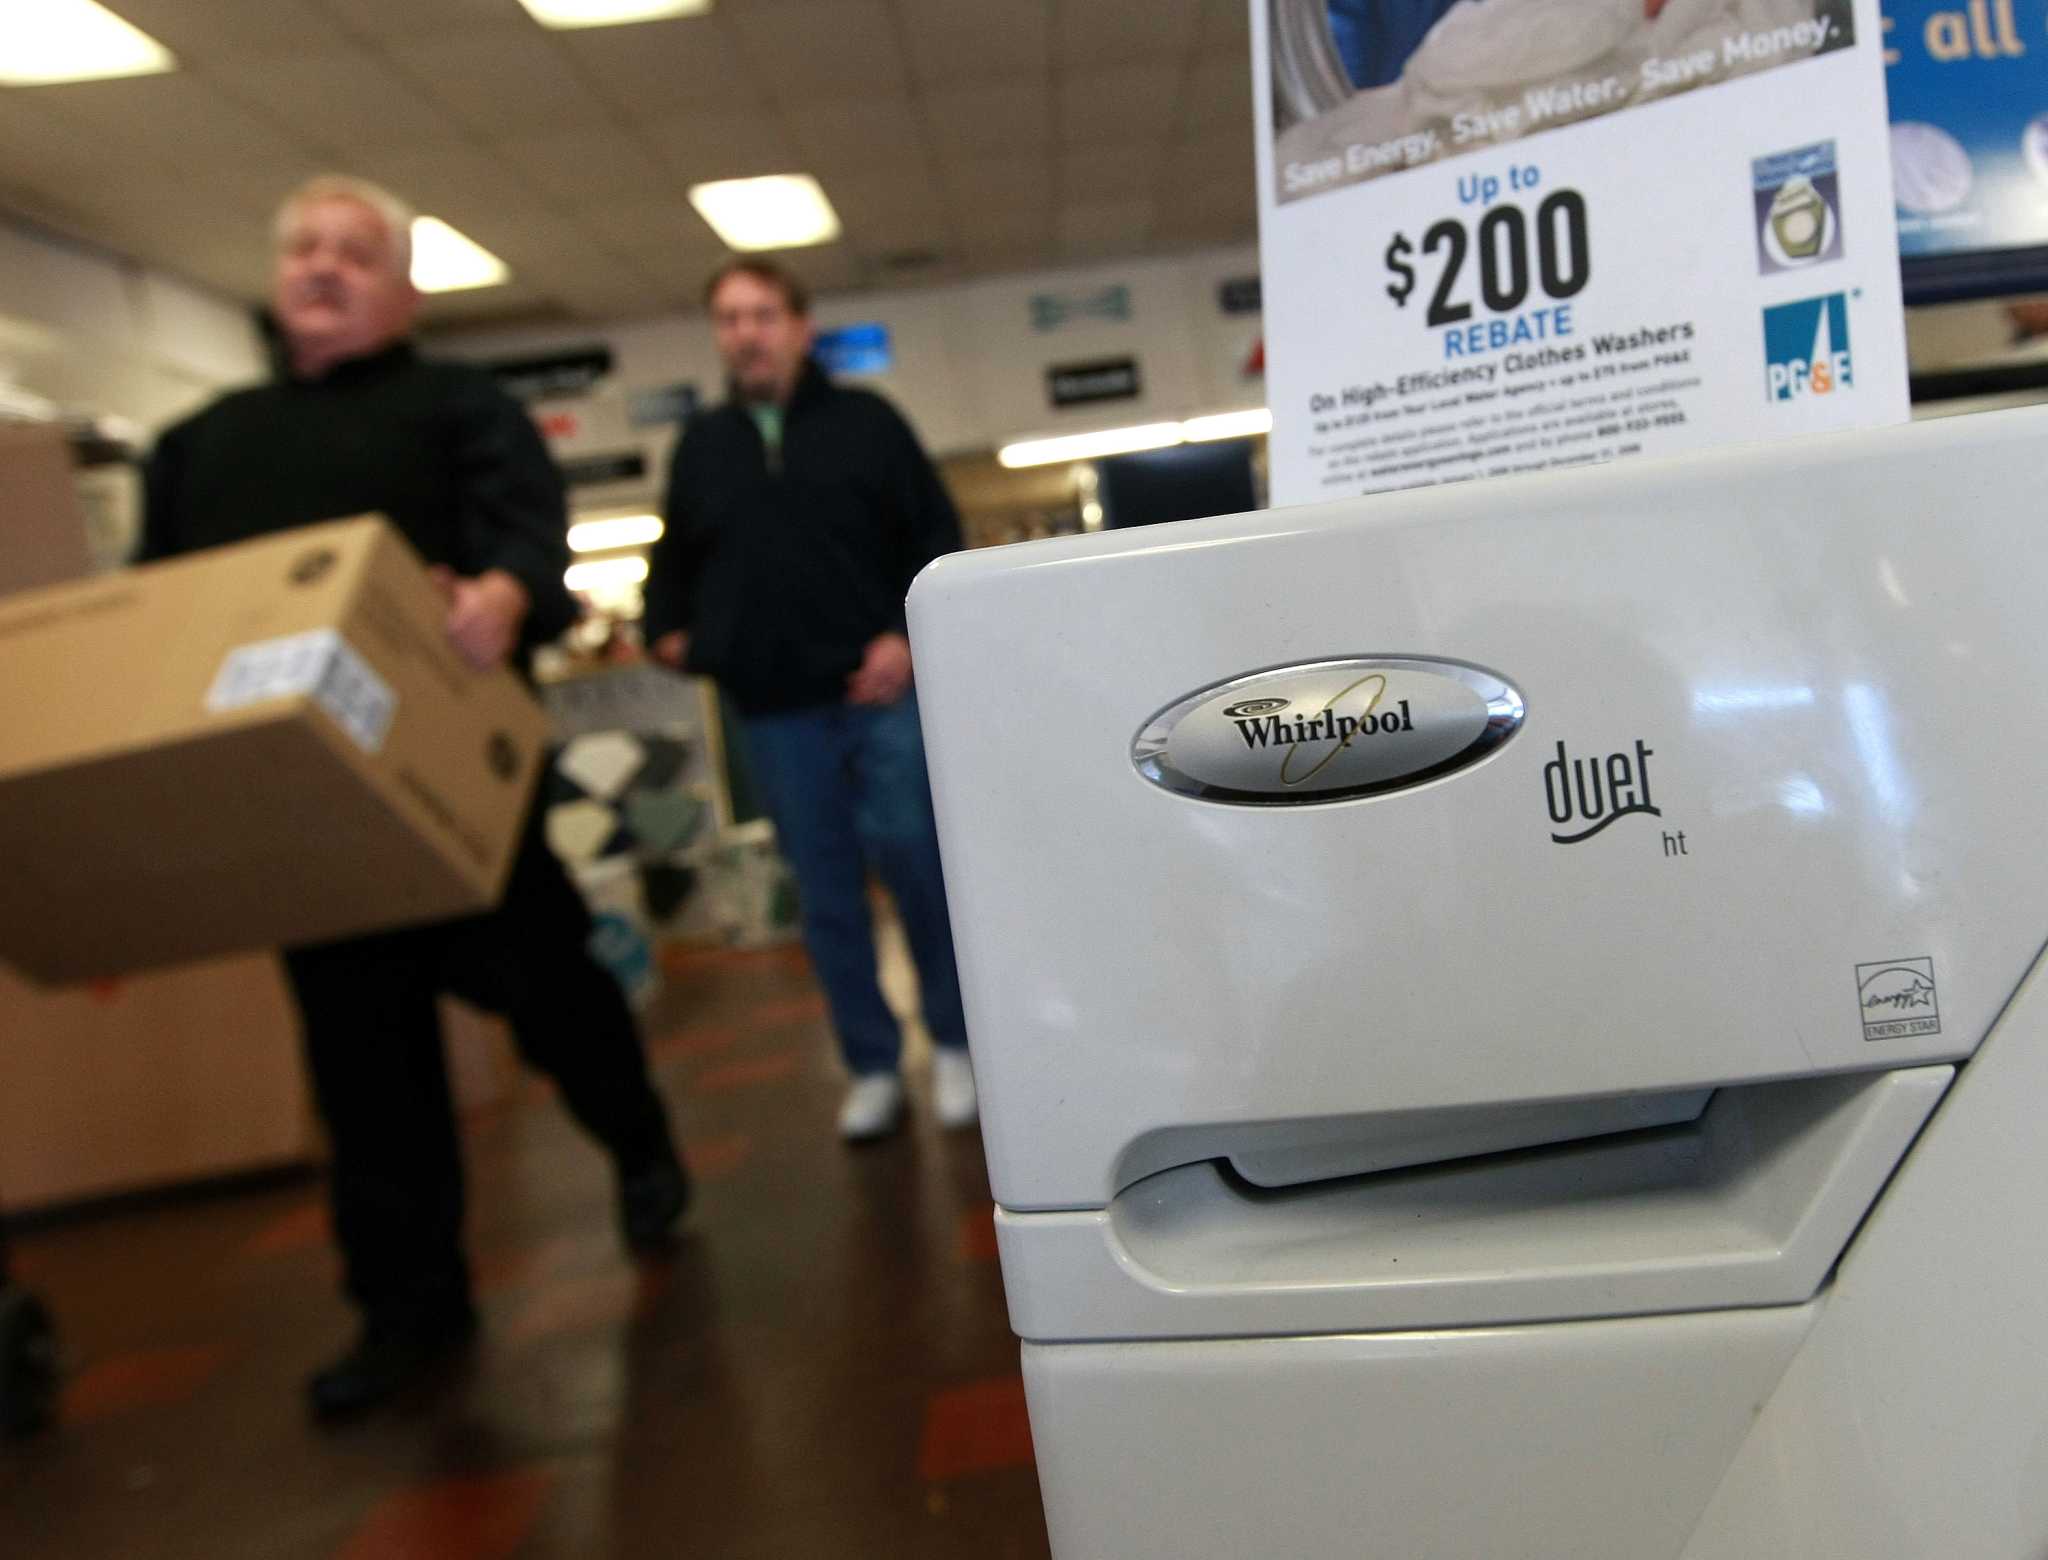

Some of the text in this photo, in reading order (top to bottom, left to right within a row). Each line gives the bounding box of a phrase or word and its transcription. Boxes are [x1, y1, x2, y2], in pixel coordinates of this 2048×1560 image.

[1925, 0, 2025, 61] all
[1284, 157, 1342, 191] Save
[1345, 128, 1442, 174] Energy.
[1452, 104, 1521, 143] Save
[1525, 77, 1626, 119] Water.
[1641, 50, 1716, 90] Save
[1722, 15, 1841, 66] Money.
[1458, 164, 1541, 205] Up to
[1385, 187, 1590, 327] $200
[1444, 304, 1574, 358] REBATE
[1309, 322, 1695, 413] On High-Efficiency Clothes Washers
[1766, 351, 1854, 401] PG&E
[1234, 699, 1415, 750] Whirlpool
[1543, 738, 1660, 838] duet
[1662, 830, 1689, 857] ht
[1866, 1020, 1937, 1037] ENERGY STAR
